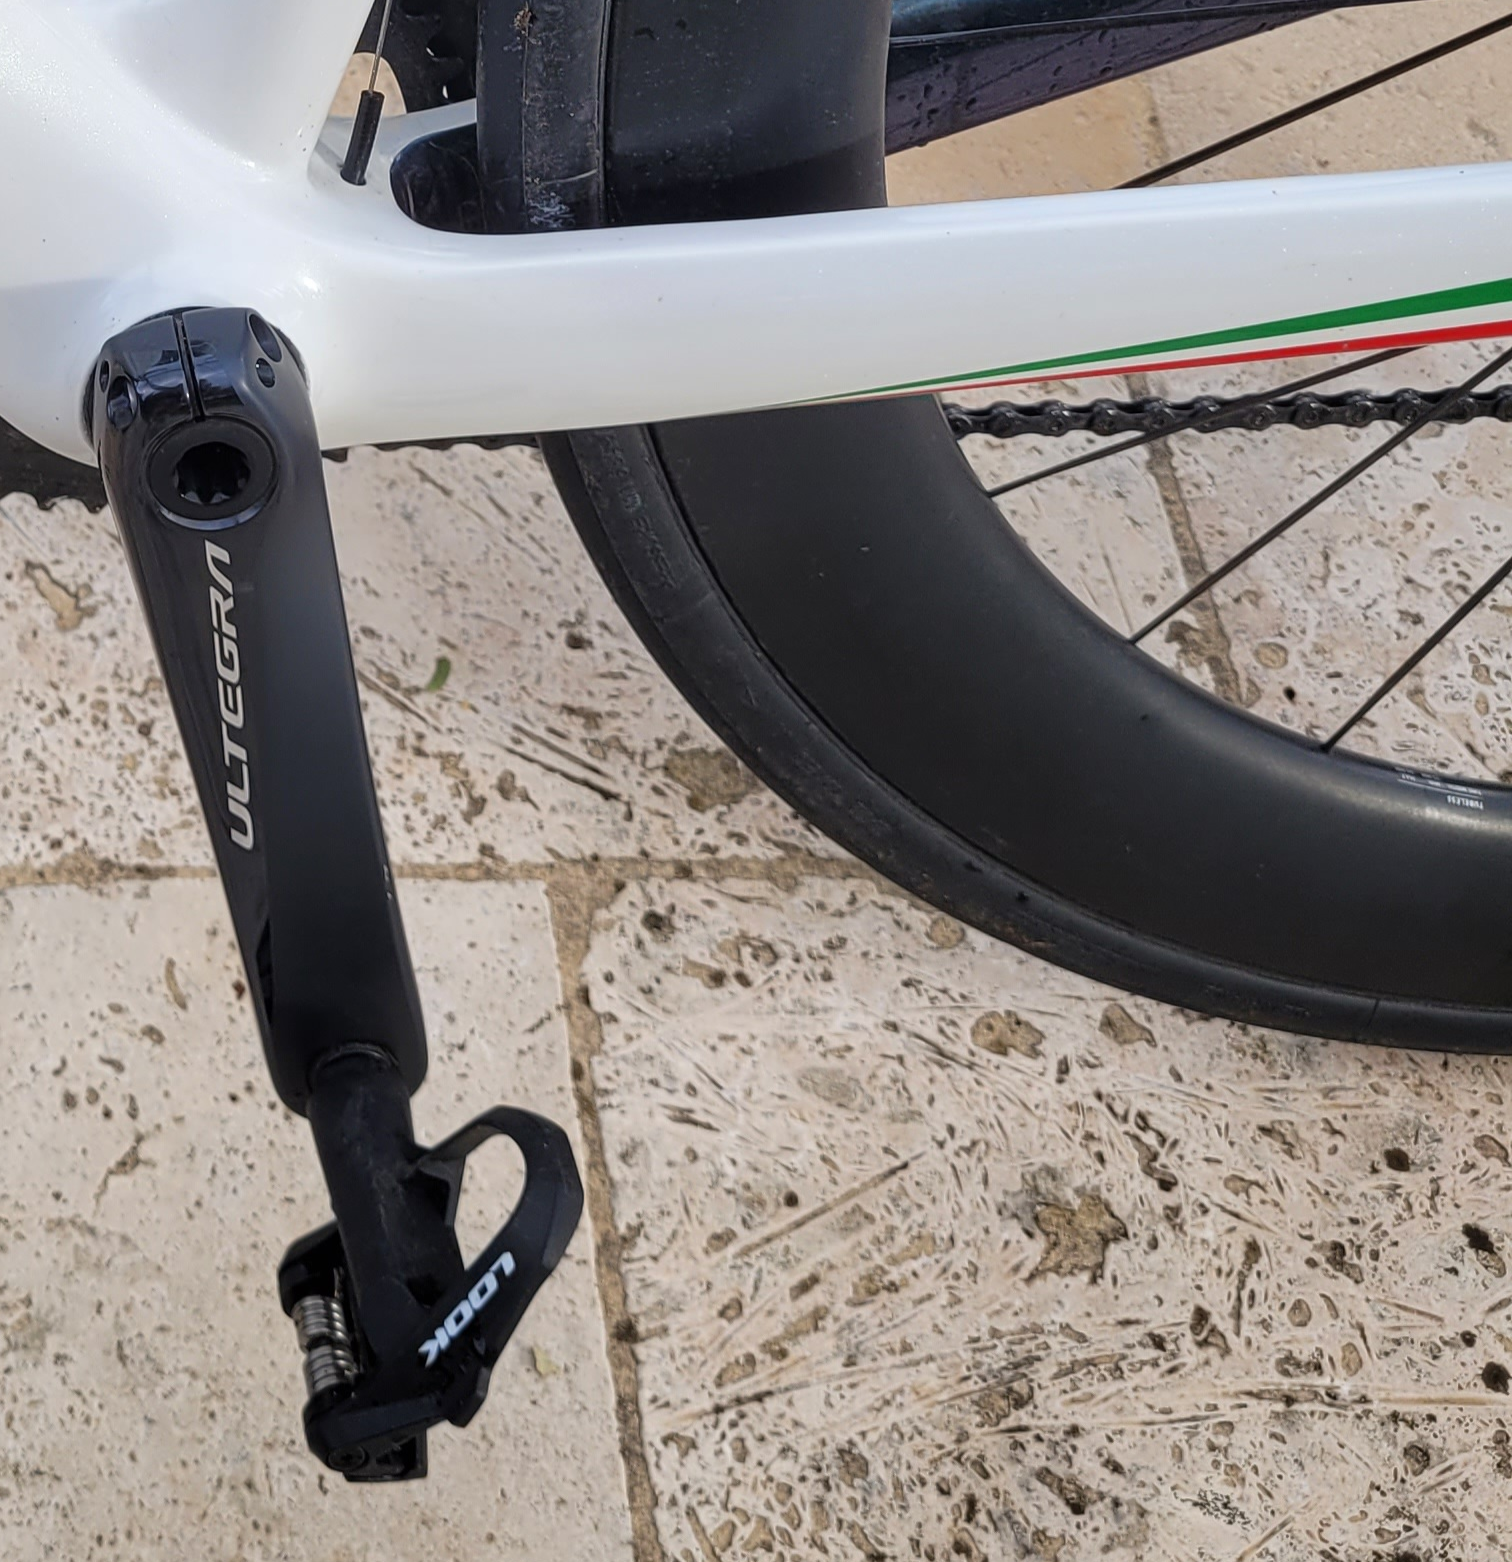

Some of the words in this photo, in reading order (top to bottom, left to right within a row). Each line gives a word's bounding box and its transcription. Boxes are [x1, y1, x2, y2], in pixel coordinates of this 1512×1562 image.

[203, 538, 255, 851] ULTEGRA
[1447, 794, 1484, 810] TUBELESS
[418, 1251, 517, 1369] LOOK
